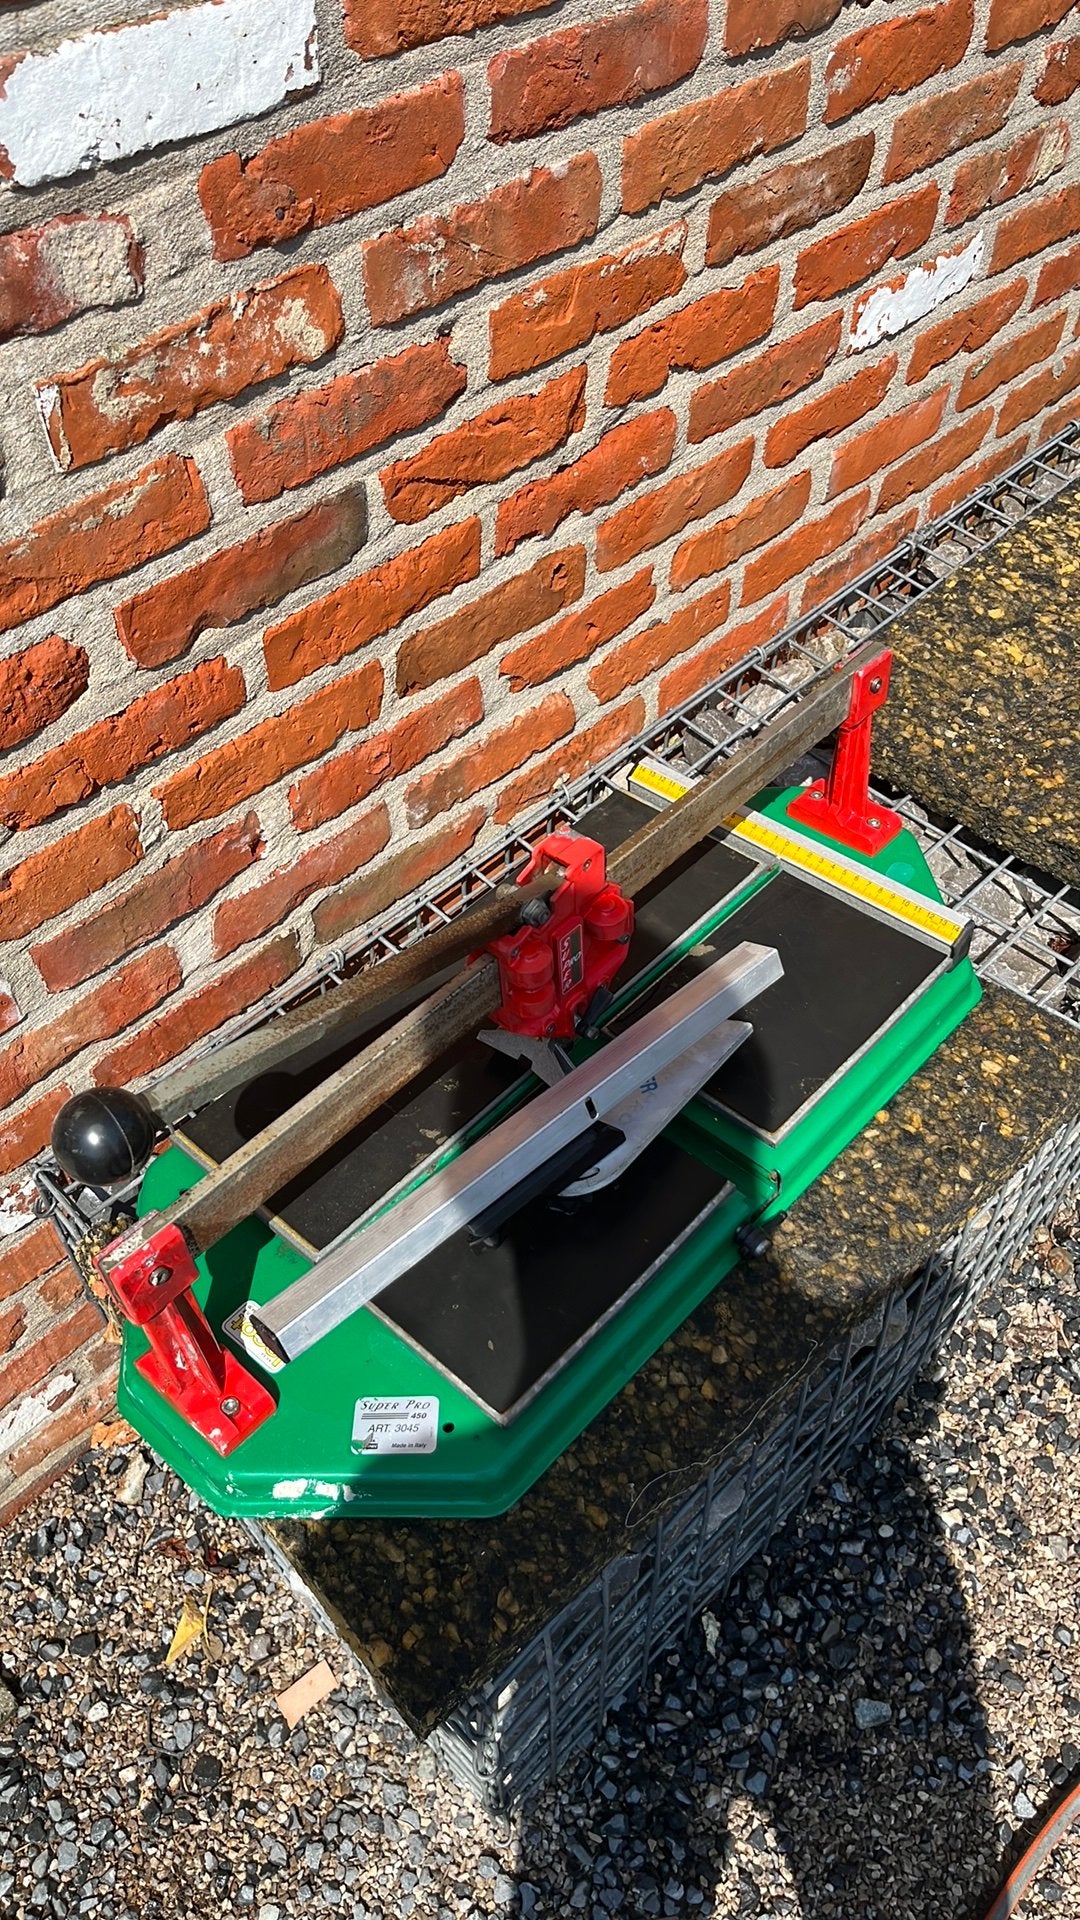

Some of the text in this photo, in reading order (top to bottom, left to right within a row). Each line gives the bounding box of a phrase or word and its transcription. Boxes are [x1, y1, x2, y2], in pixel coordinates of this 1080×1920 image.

[410, 1412, 427, 1420] 450
[367, 1423, 421, 1433] ART. 3045
[414, 1442, 428, 1450] Italy
